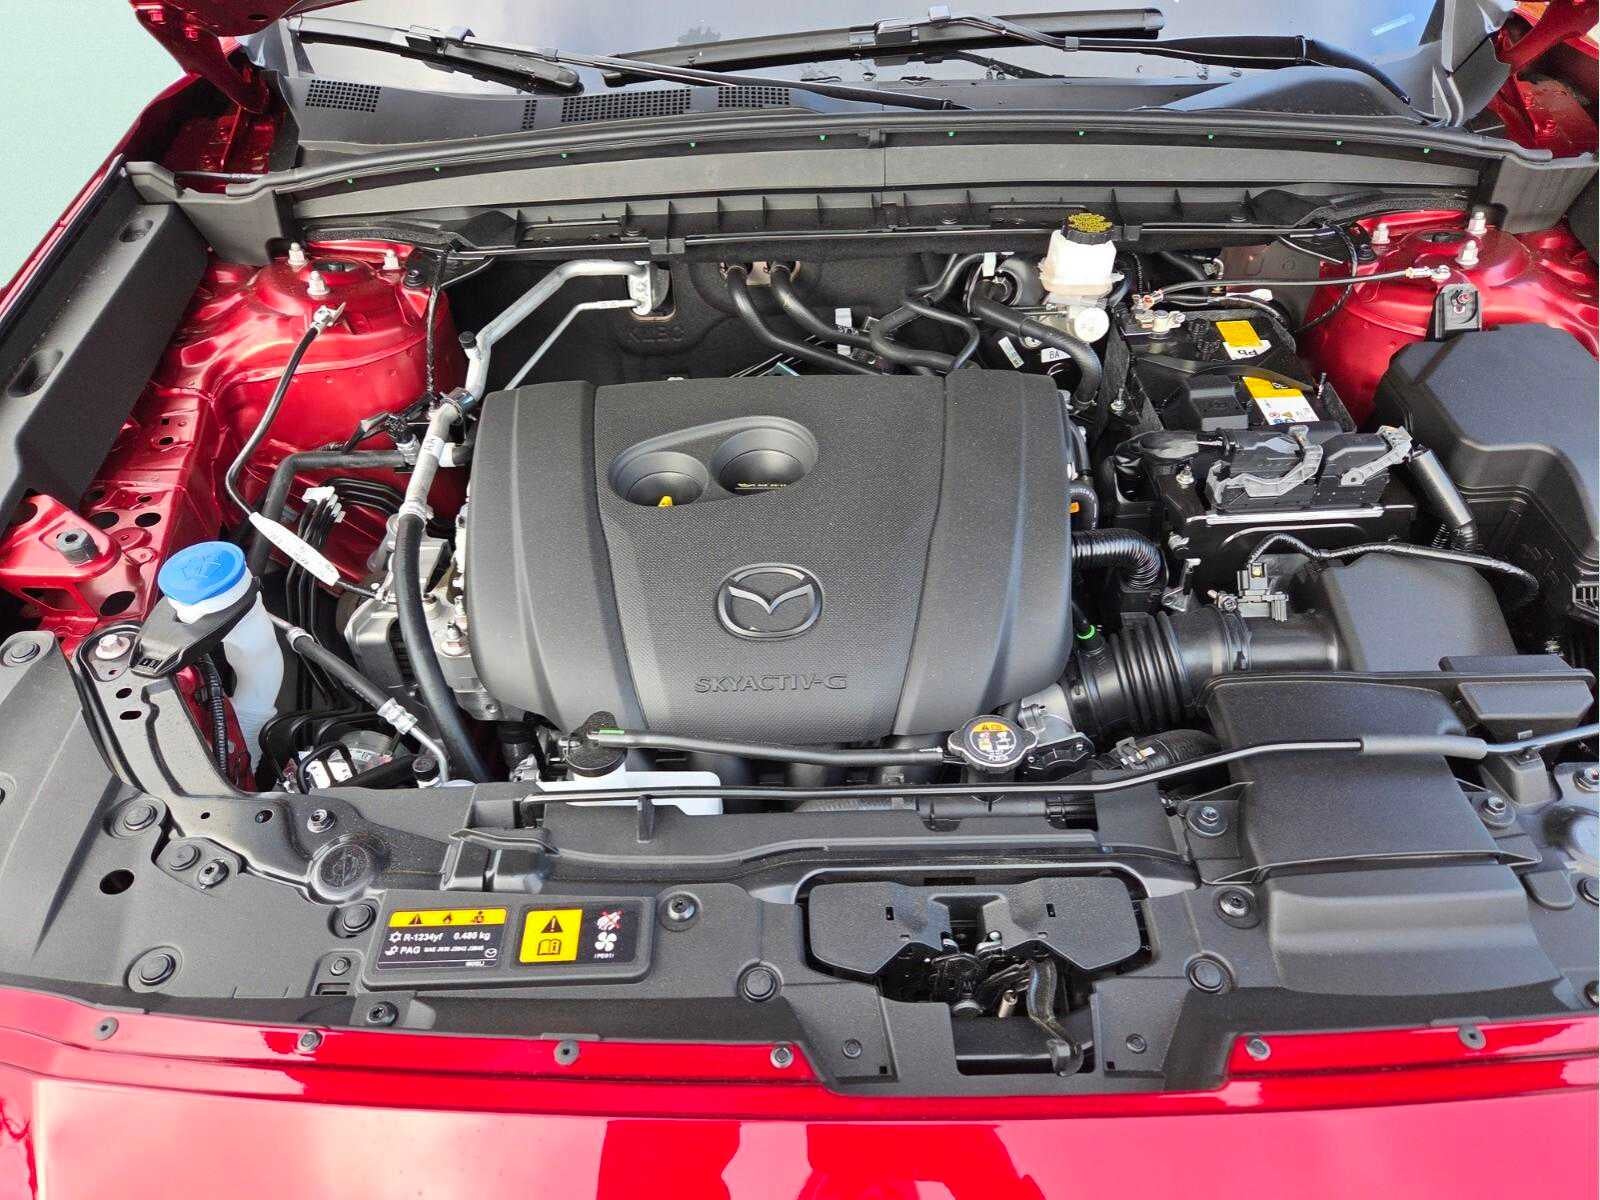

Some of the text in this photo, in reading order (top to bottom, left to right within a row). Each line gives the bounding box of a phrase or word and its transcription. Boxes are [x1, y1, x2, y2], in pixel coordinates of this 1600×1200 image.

[695, 674, 847, 693] SKYACTIV-G
[403, 932, 444, 943] R-1234yf
[479, 931, 491, 941] kg
[400, 946, 420, 954] PAG
